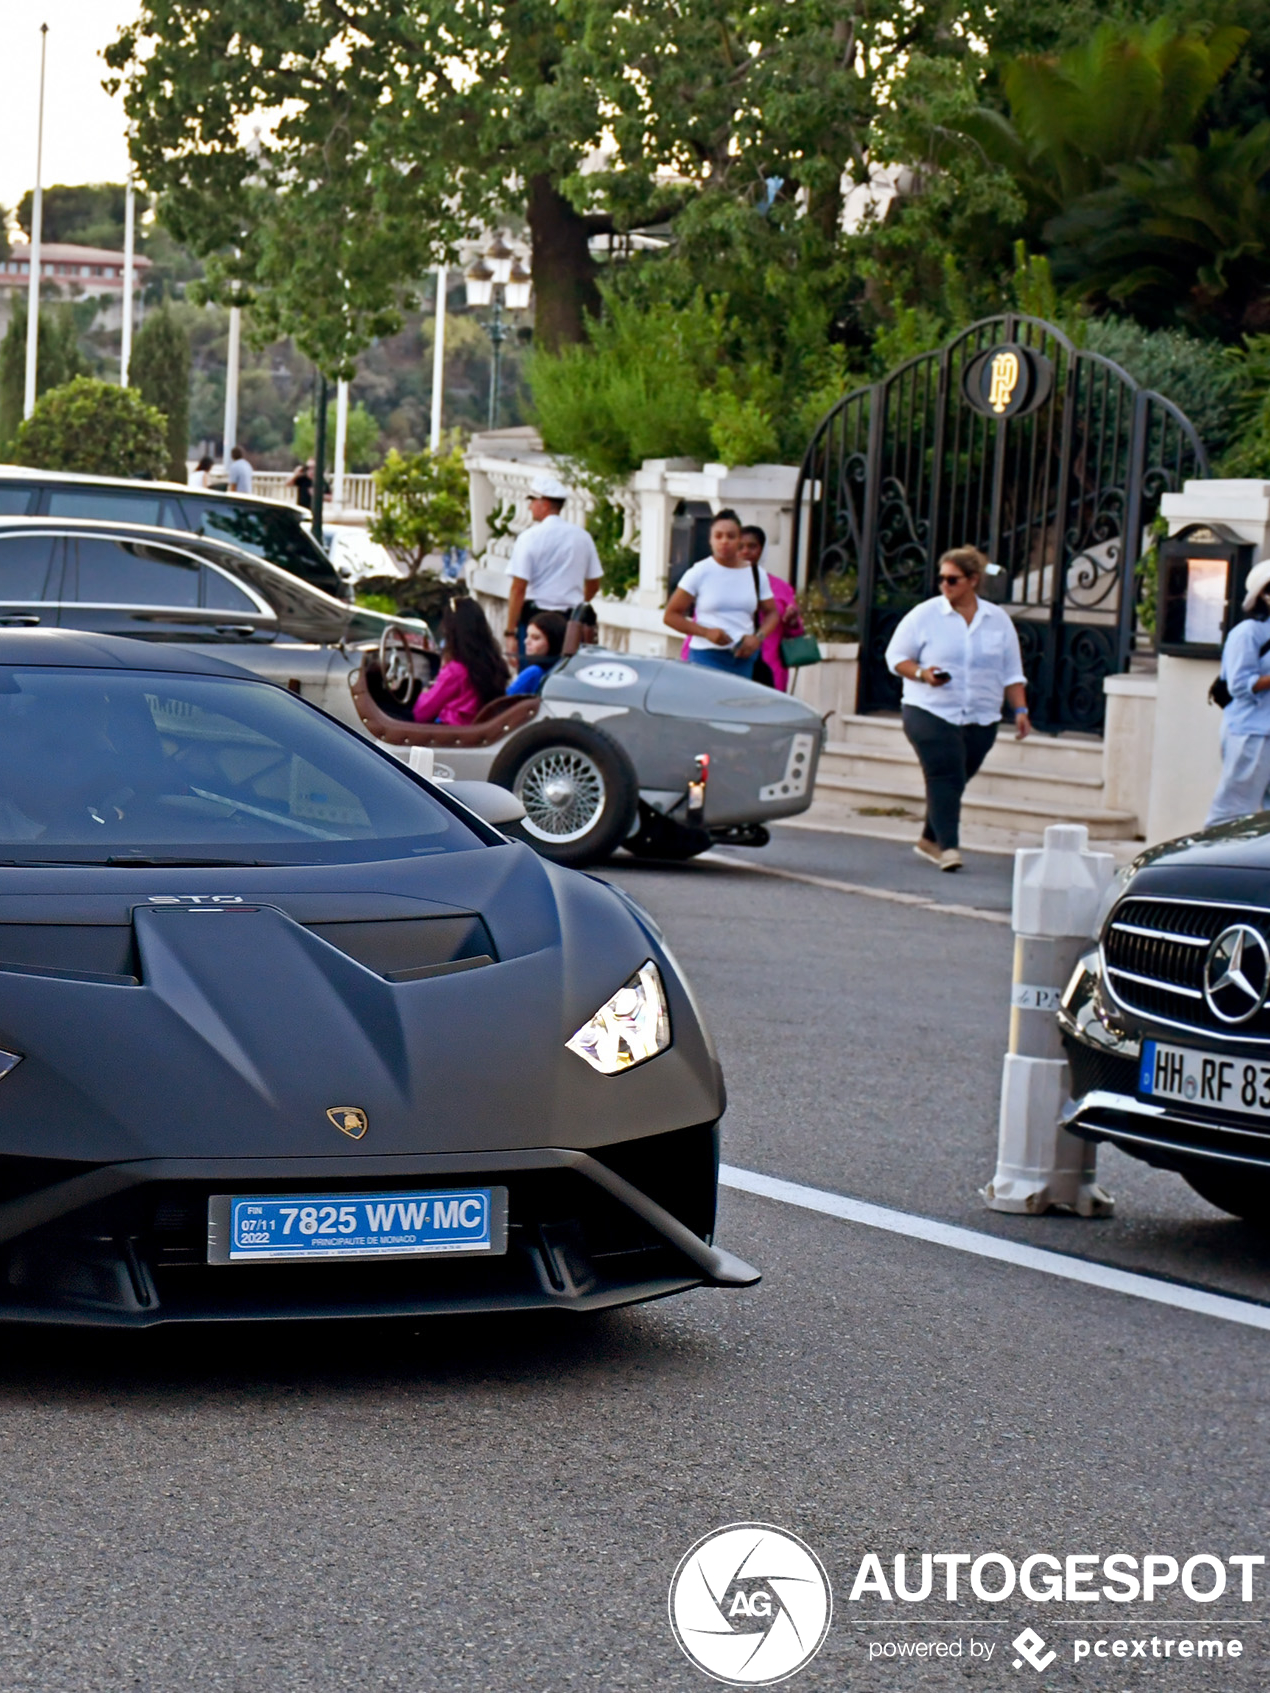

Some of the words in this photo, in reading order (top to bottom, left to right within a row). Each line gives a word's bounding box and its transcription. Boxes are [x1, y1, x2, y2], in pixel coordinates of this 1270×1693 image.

[147, 895, 243, 904] STO
[1154, 1050, 1184, 1094] HH
[1201, 1058, 1234, 1102] RF
[247, 1206, 263, 1215] FIN
[241, 1219, 276, 1231] 07/11
[280, 1206, 357, 1235] 7825
[240, 1232, 270, 1244] 2022
[311, 1236, 365, 1246] PRINCIPAUTE
[366, 1236, 378, 1245] DE
[380, 1234, 416, 1244] MONACO
